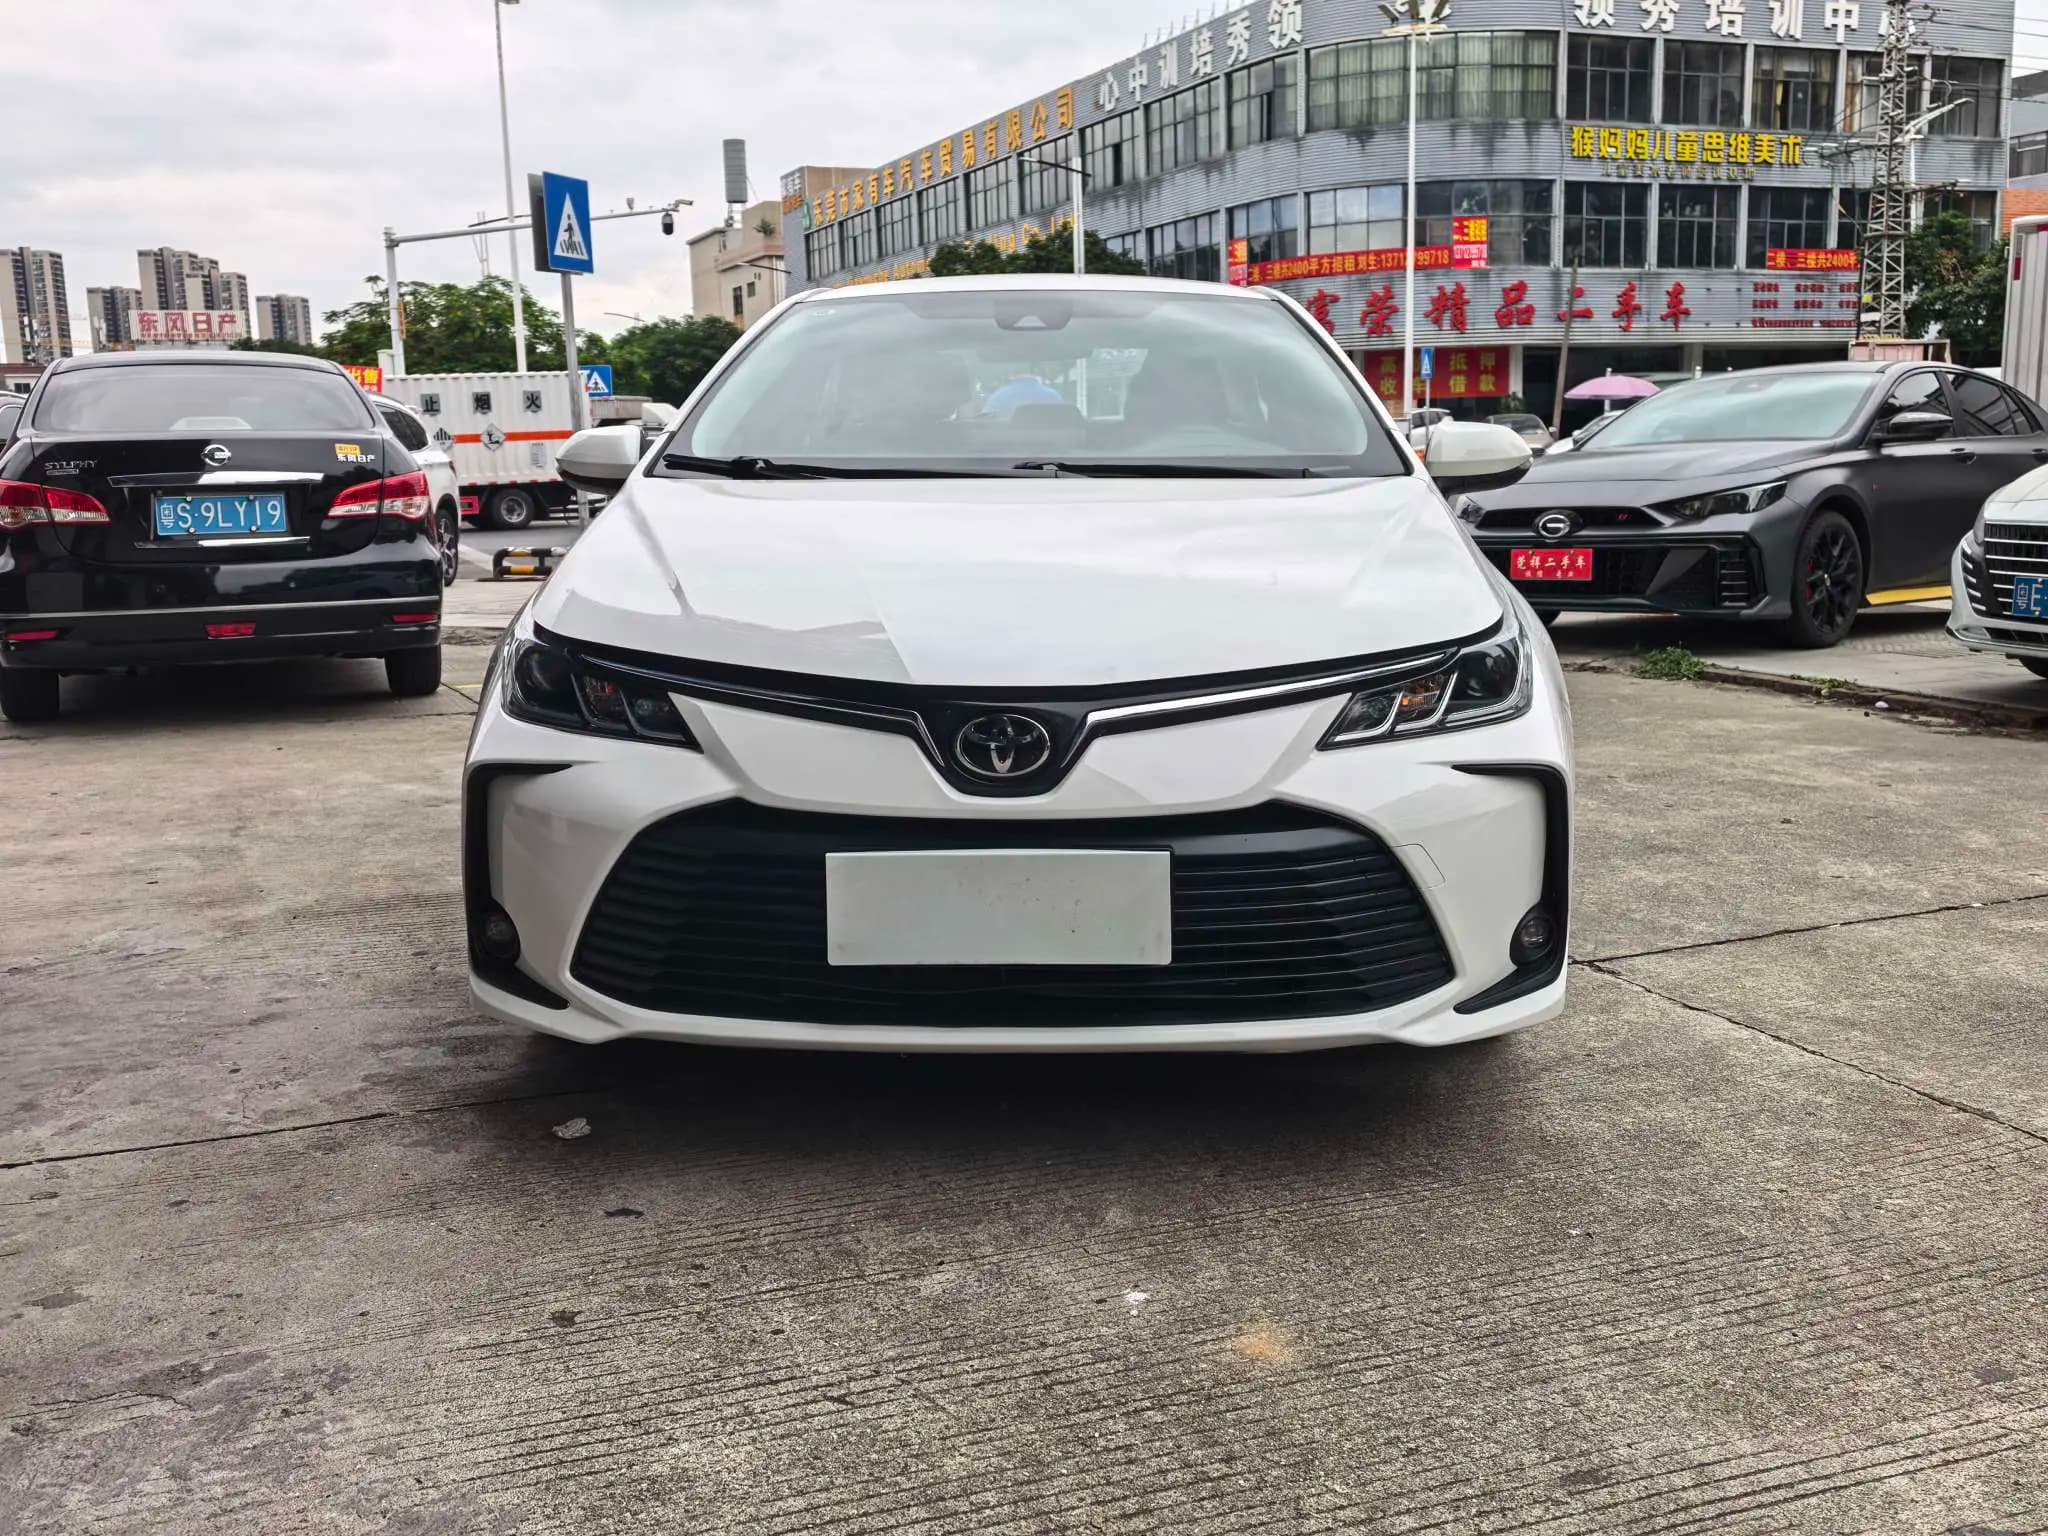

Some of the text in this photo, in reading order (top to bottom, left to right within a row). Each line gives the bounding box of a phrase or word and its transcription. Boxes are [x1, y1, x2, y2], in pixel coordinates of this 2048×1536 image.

[1571, 126, 1804, 165] 猴妈妈儿童思维美术
[138, 312, 237, 338] 东风日产
[1305, 280, 1692, 336] 富荣精品二手车
